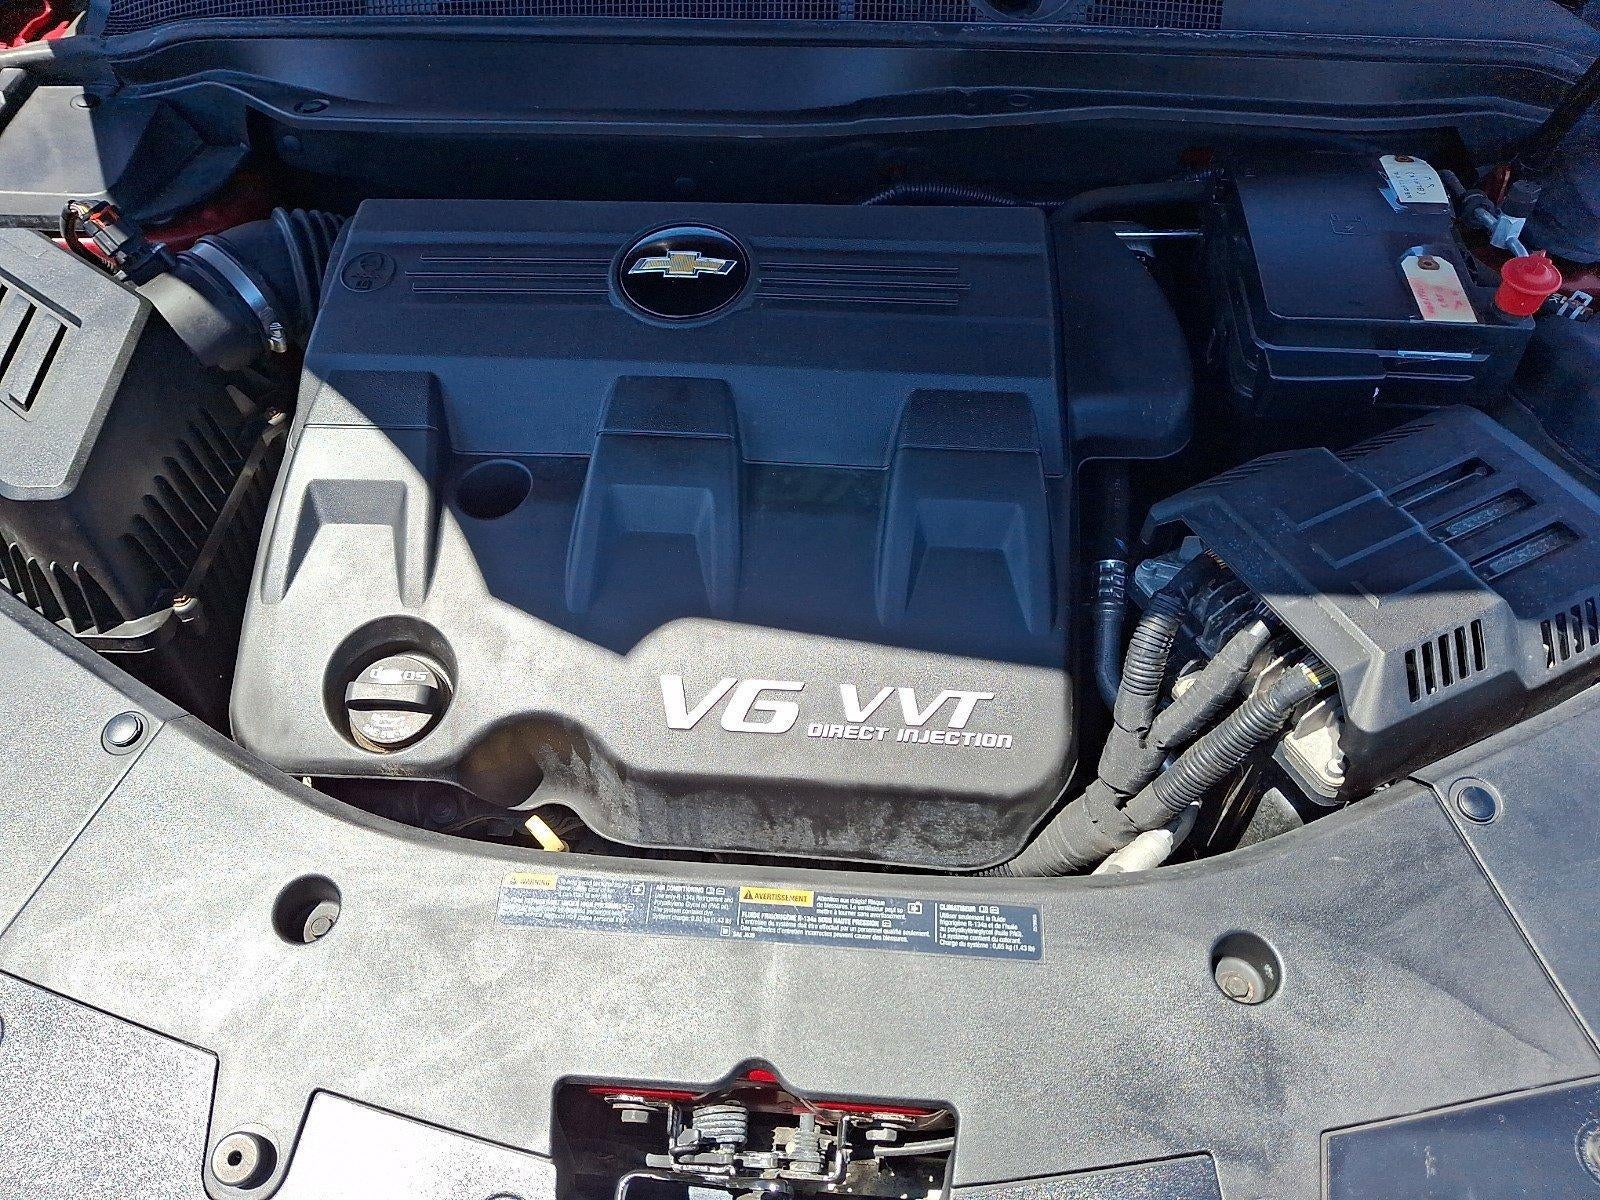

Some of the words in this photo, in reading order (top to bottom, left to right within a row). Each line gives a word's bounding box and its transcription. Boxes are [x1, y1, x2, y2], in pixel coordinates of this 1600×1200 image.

[370, 666, 429, 681] dos
[659, 674, 805, 734] V6
[840, 683, 995, 728] VVT
[807, 722, 889, 741] DIRECT
[897, 728, 1012, 748] INJECTION
[755, 893, 807, 902] AVERTISSEMENT
